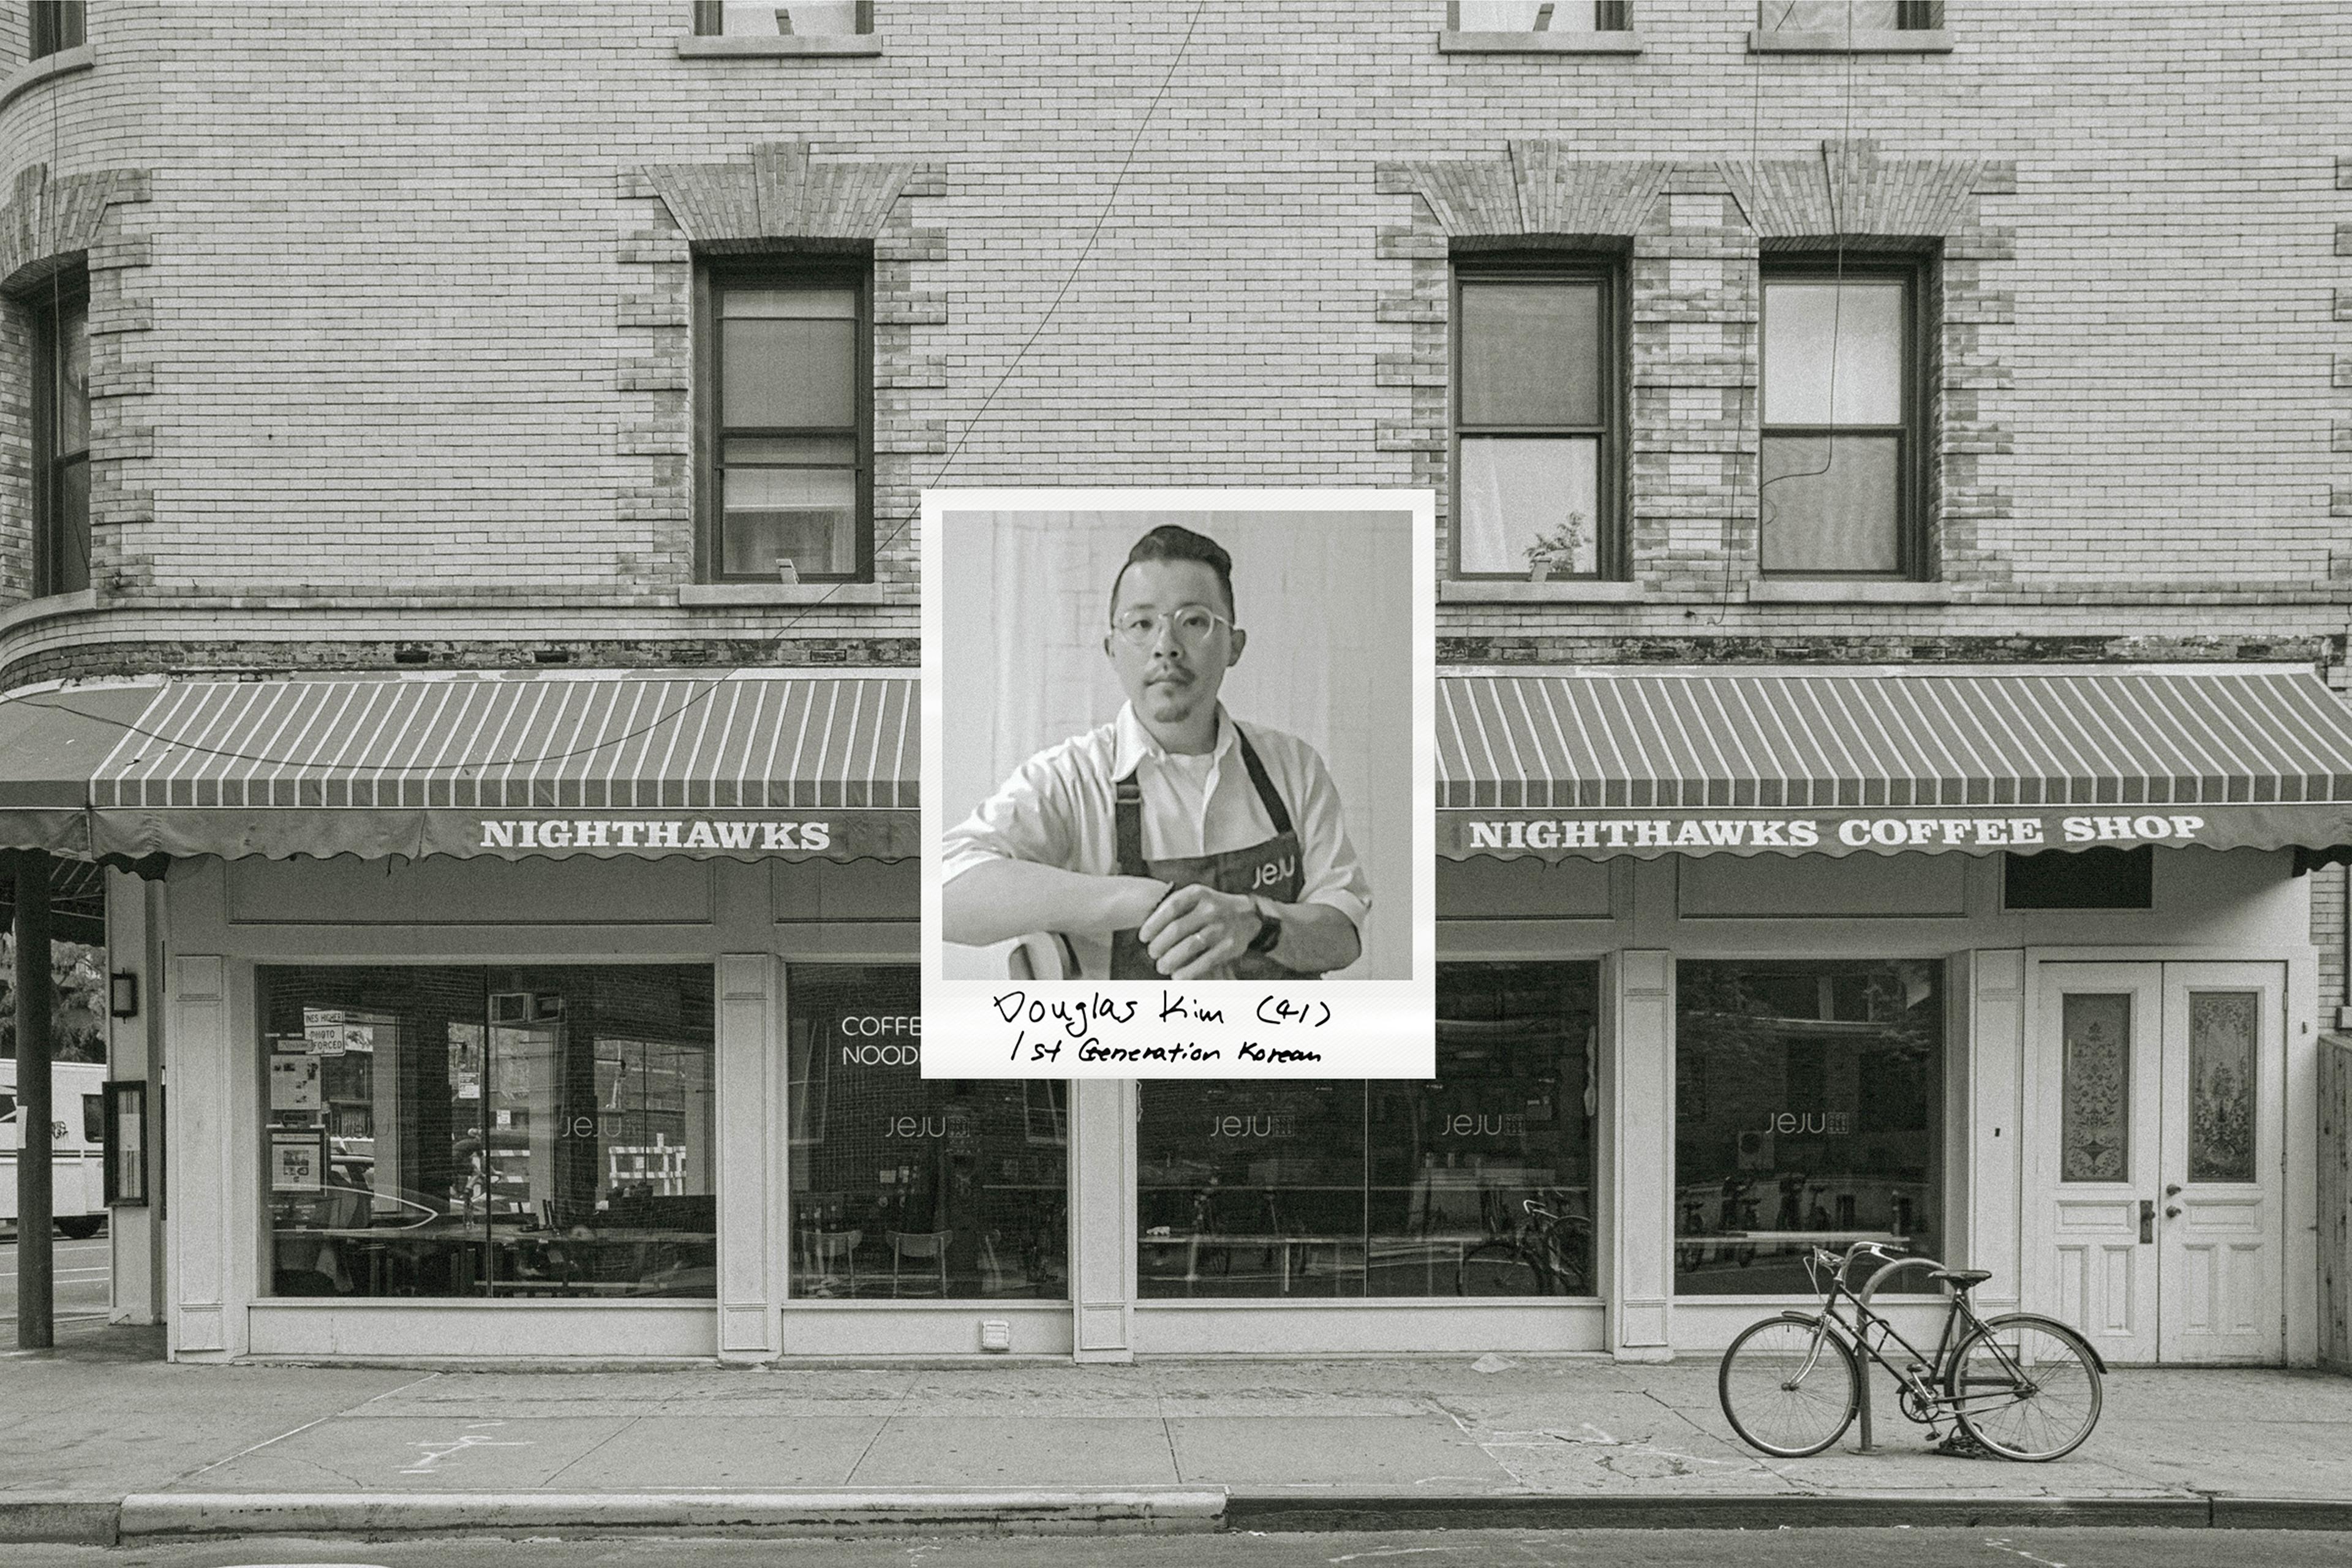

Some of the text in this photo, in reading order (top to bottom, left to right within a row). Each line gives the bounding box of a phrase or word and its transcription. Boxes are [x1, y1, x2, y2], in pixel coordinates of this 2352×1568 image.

[480, 820, 830, 850] NIGHTHAWKS
[1469, 815, 2204, 849] NIGHTHAWKS COFFEE SHOP
[843, 1045, 921, 1066] NOOD
